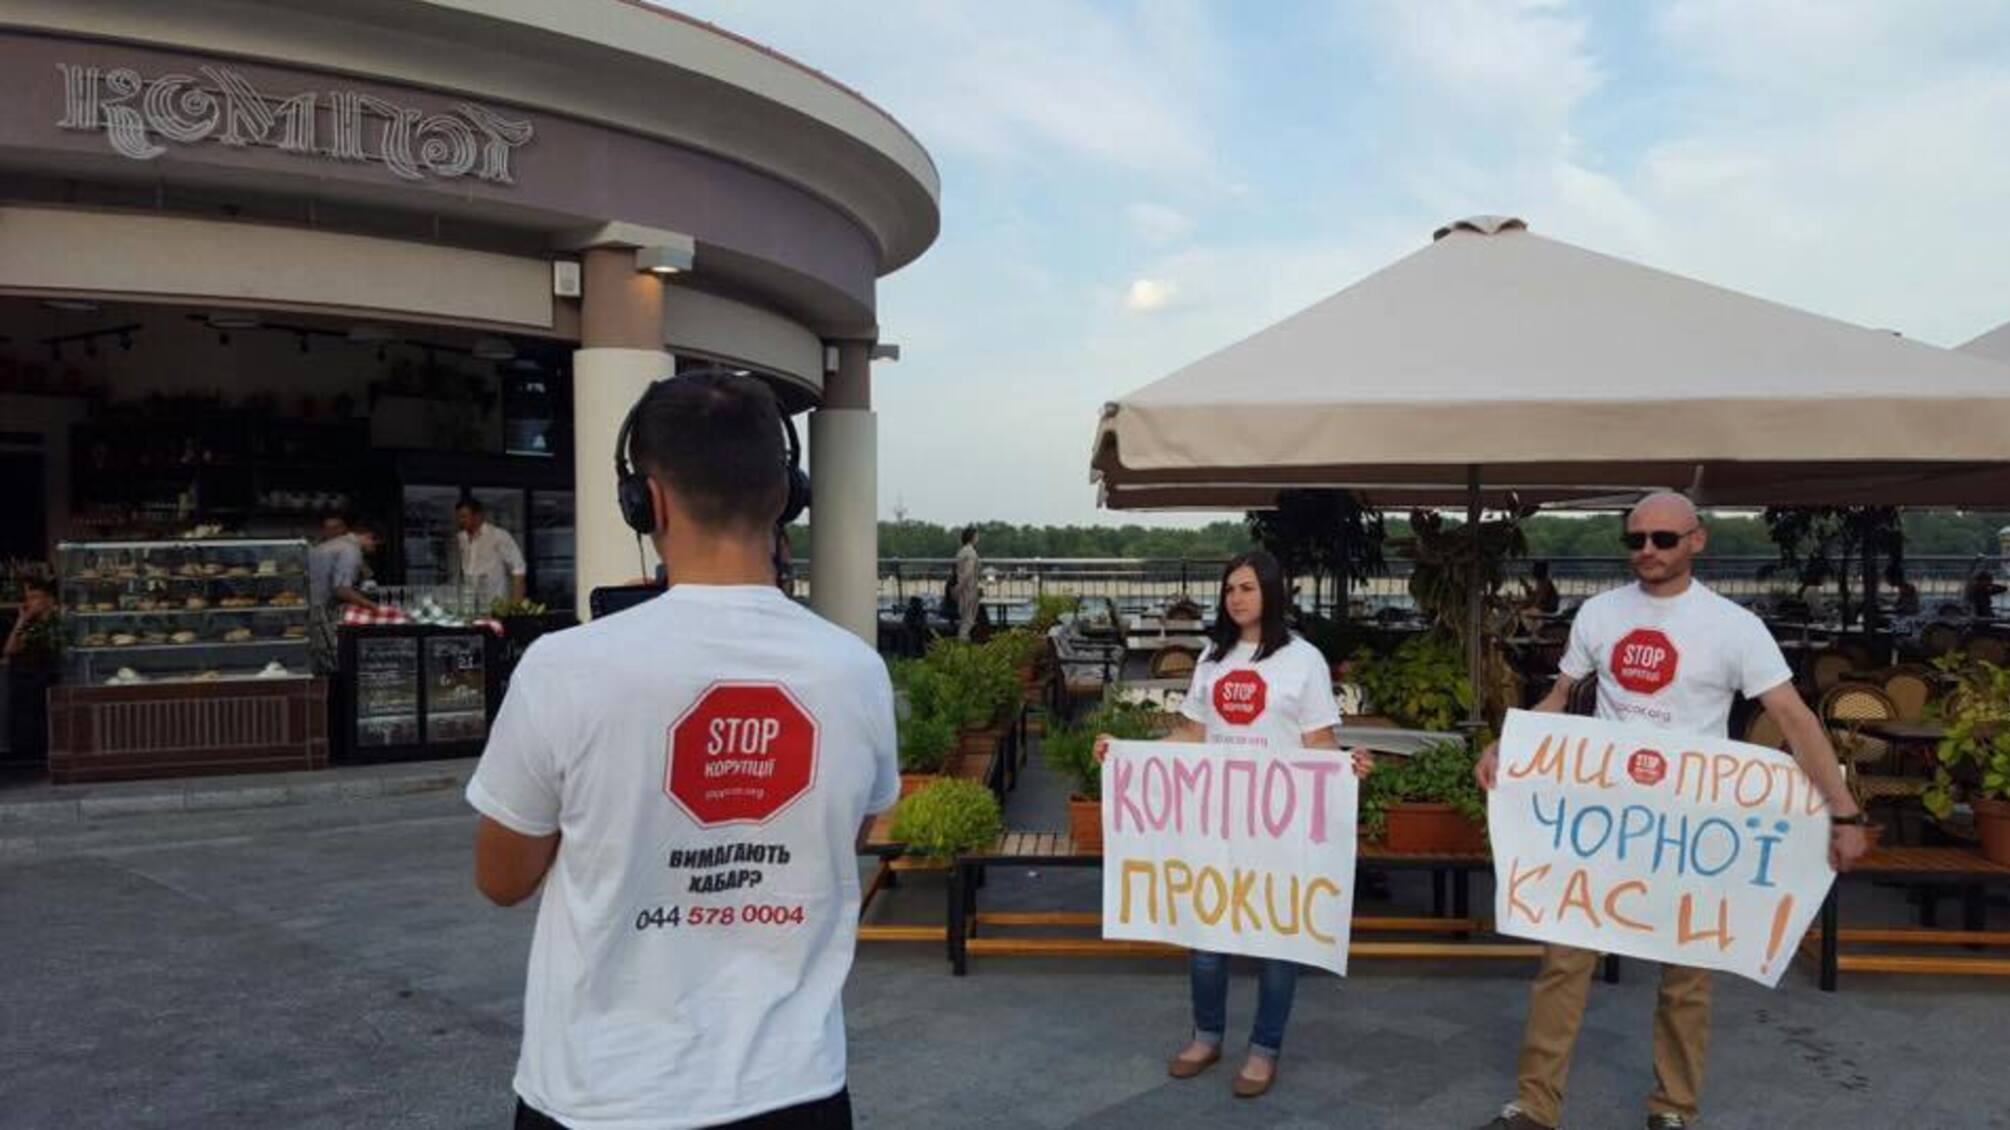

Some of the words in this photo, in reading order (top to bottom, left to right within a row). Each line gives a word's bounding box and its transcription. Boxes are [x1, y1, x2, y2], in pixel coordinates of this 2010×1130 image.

[1622, 644, 1666, 670] STOP
[1222, 681, 1257, 701] STOP
[707, 717, 780, 756] STOP
[704, 758, 776, 778] КОРУПЦІЇ
[1112, 755, 1342, 845] КОМПОТ
[1532, 792, 1790, 888] ЧОРНОЇ
[669, 843, 791, 868] ВИМАГАЮТЬ
[687, 869, 763, 894] ХАБАР?
[1119, 859, 1342, 945] ПРОКИС
[635, 906, 681, 931] 044
[687, 906, 735, 925] 578
[741, 904, 805, 925] 0004
